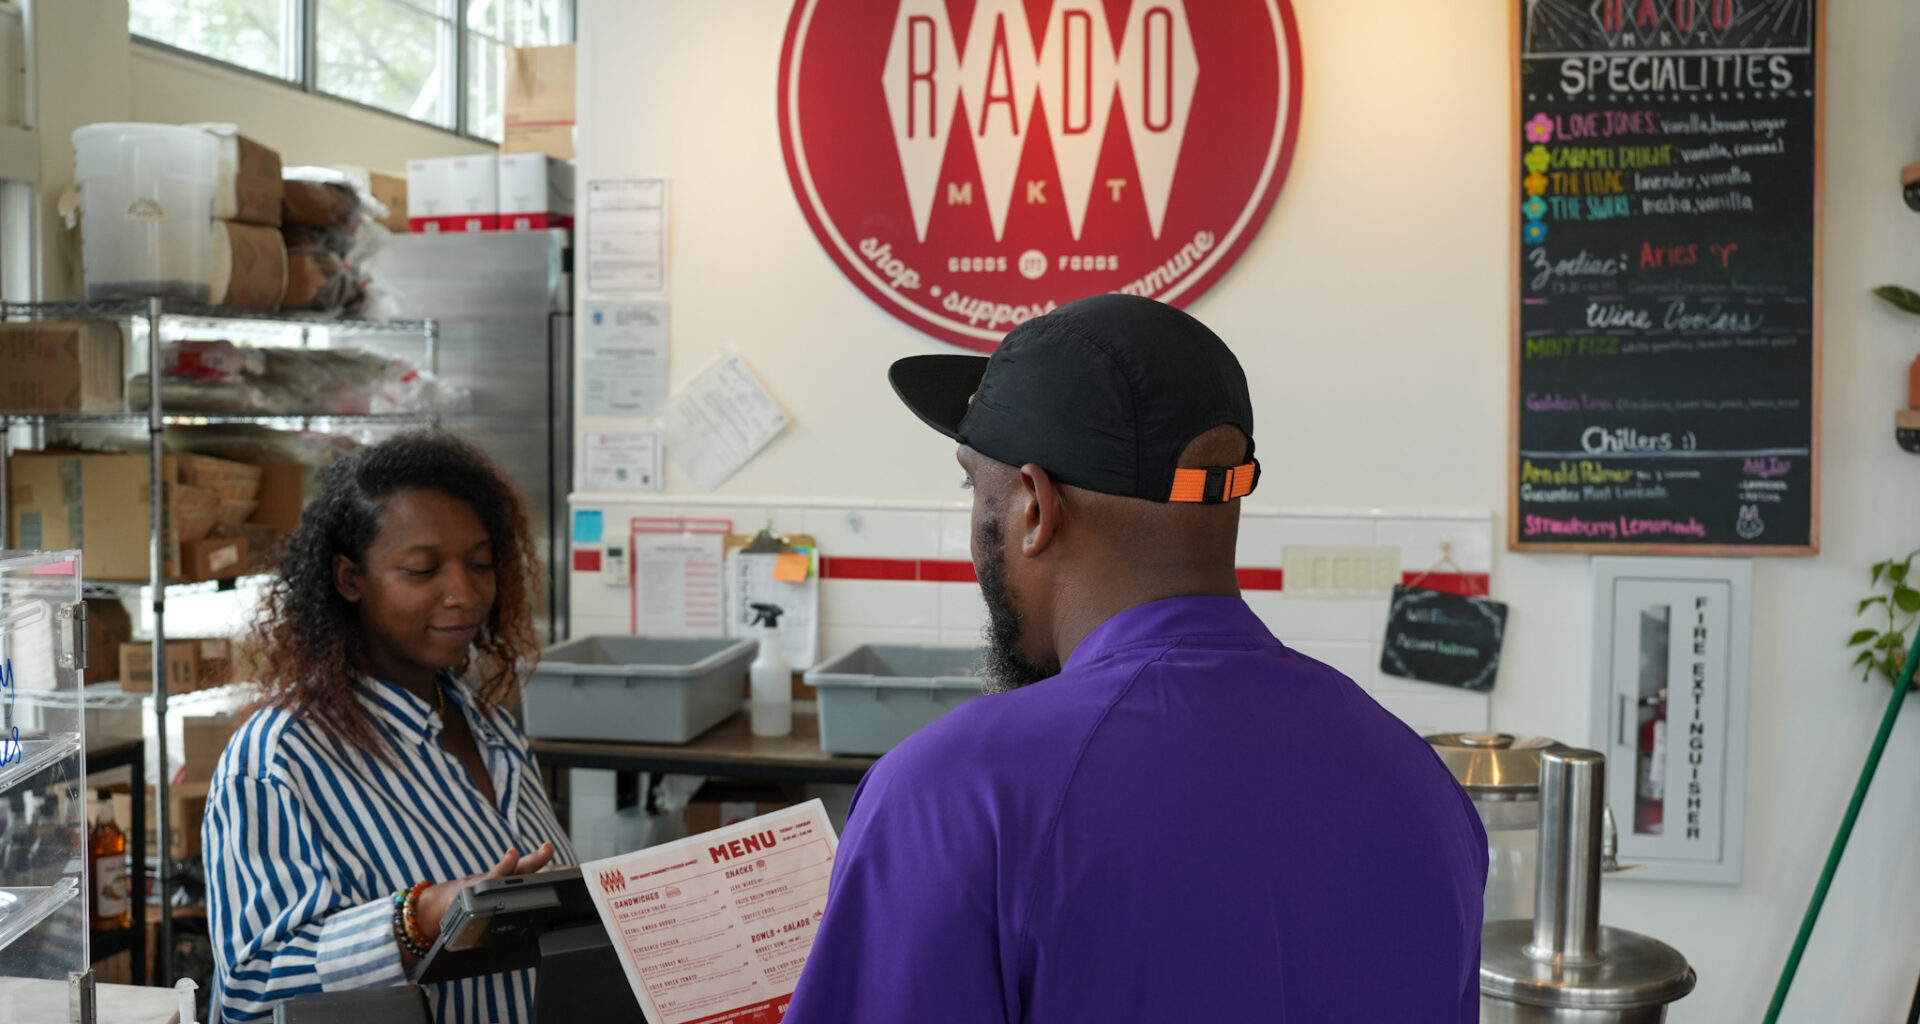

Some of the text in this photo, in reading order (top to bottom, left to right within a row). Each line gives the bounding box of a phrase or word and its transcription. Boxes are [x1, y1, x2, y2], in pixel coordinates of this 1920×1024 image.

[908, 7, 1172, 139] RADO
[1560, 54, 1793, 94] SPECIALITIES
[1556, 113, 1600, 140] LOVE
[948, 179, 1127, 205] MKT
[859, 237, 921, 289] shop
[948, 256, 1007, 272] GOODS
[1058, 255, 1118, 271] FOODS
[1640, 241, 1697, 269] Aries
[1586, 301, 1764, 332] Wine Coolers
[1582, 426, 1672, 453] Chillers
[1521, 459, 1579, 484] Arnold
[1524, 514, 1616, 539] Strawberry
[1686, 596, 1708, 839] FIRE EXTINGUISHER
[708, 830, 777, 864] MENU
[725, 865, 754, 879] SNACKS
[614, 891, 660, 909] SANDWICHES
[751, 929, 775, 943] BOWLS
[782, 918, 811, 932] SALADS
